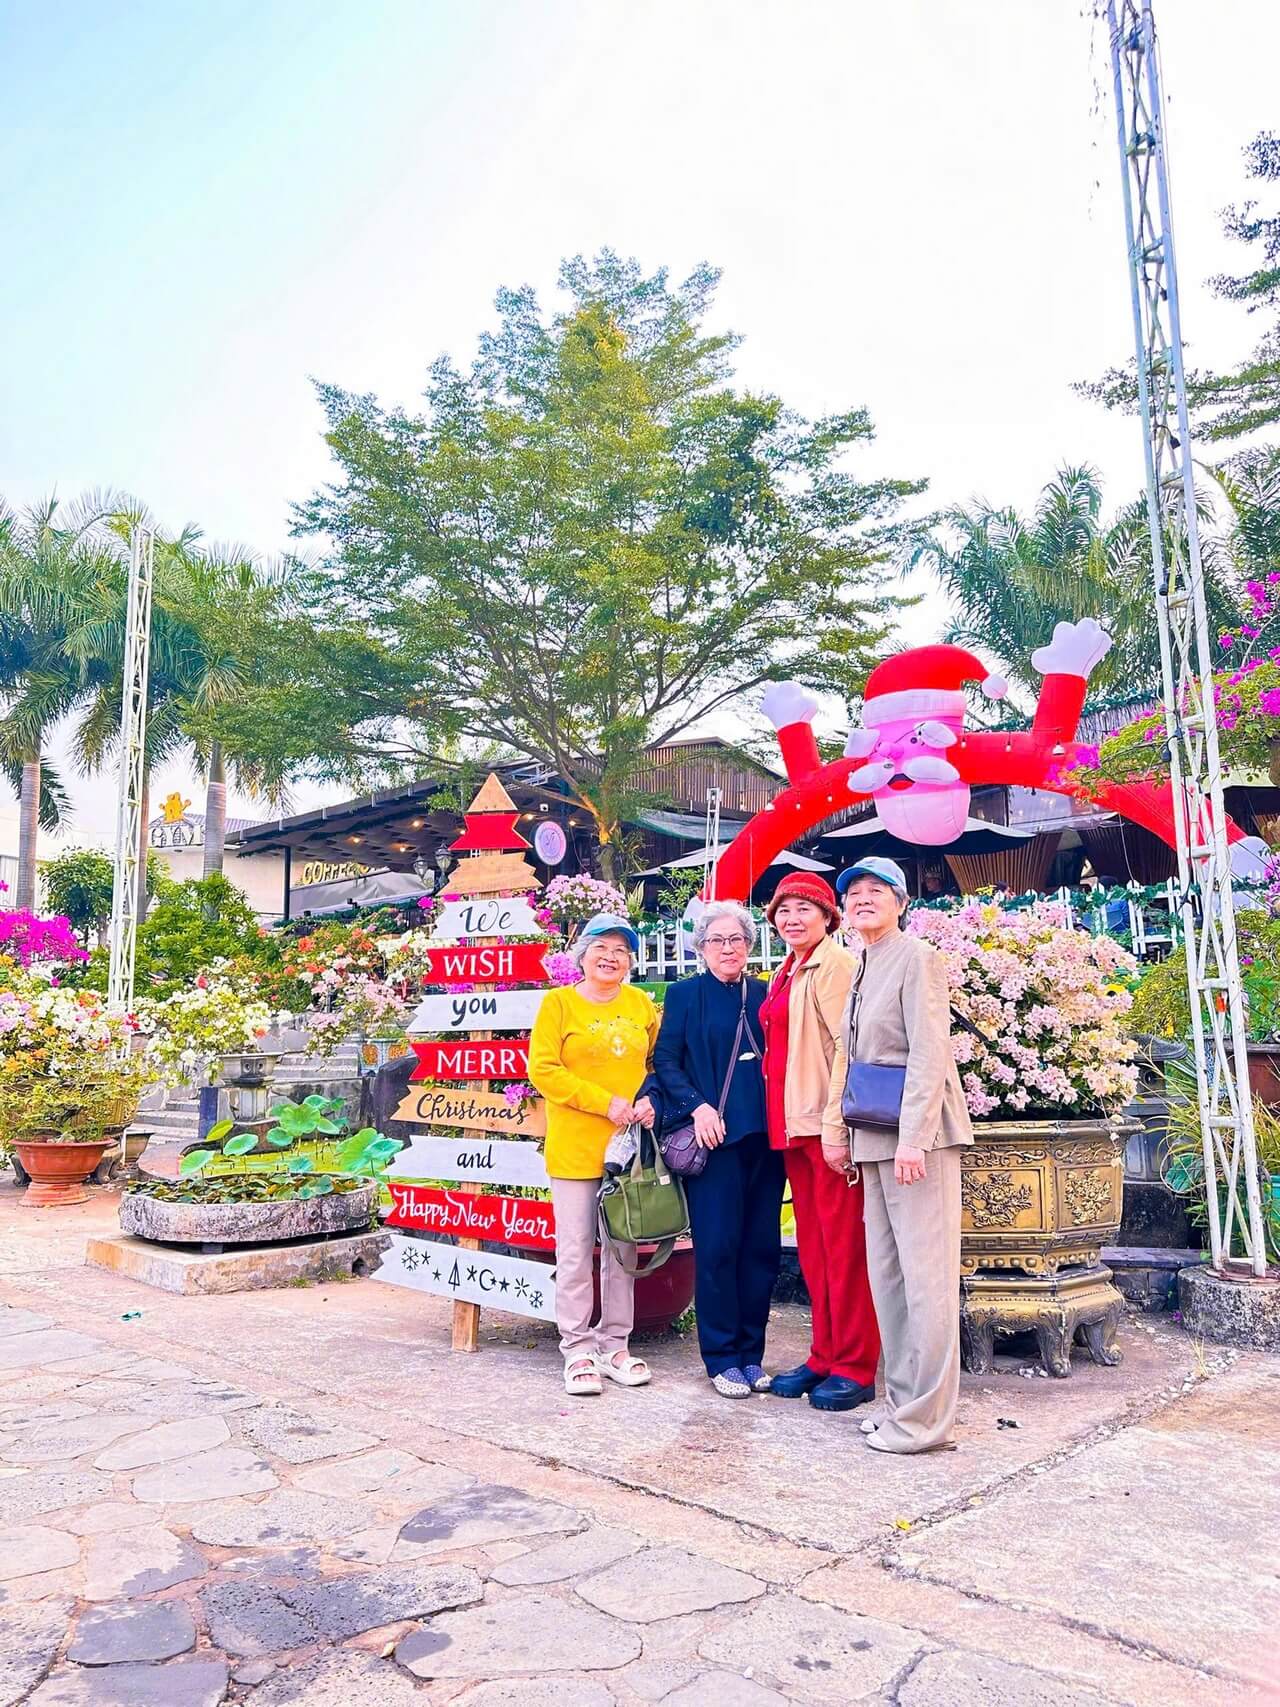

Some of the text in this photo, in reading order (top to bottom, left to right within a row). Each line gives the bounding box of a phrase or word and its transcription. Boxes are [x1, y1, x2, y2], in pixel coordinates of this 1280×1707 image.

[459, 901, 513, 933] We
[443, 949, 515, 977] WISH
[451, 998, 498, 1027] you
[416, 1093, 530, 1125] Christmas
[456, 1144, 497, 1169] and
[393, 1187, 557, 1240] Happy New Year
